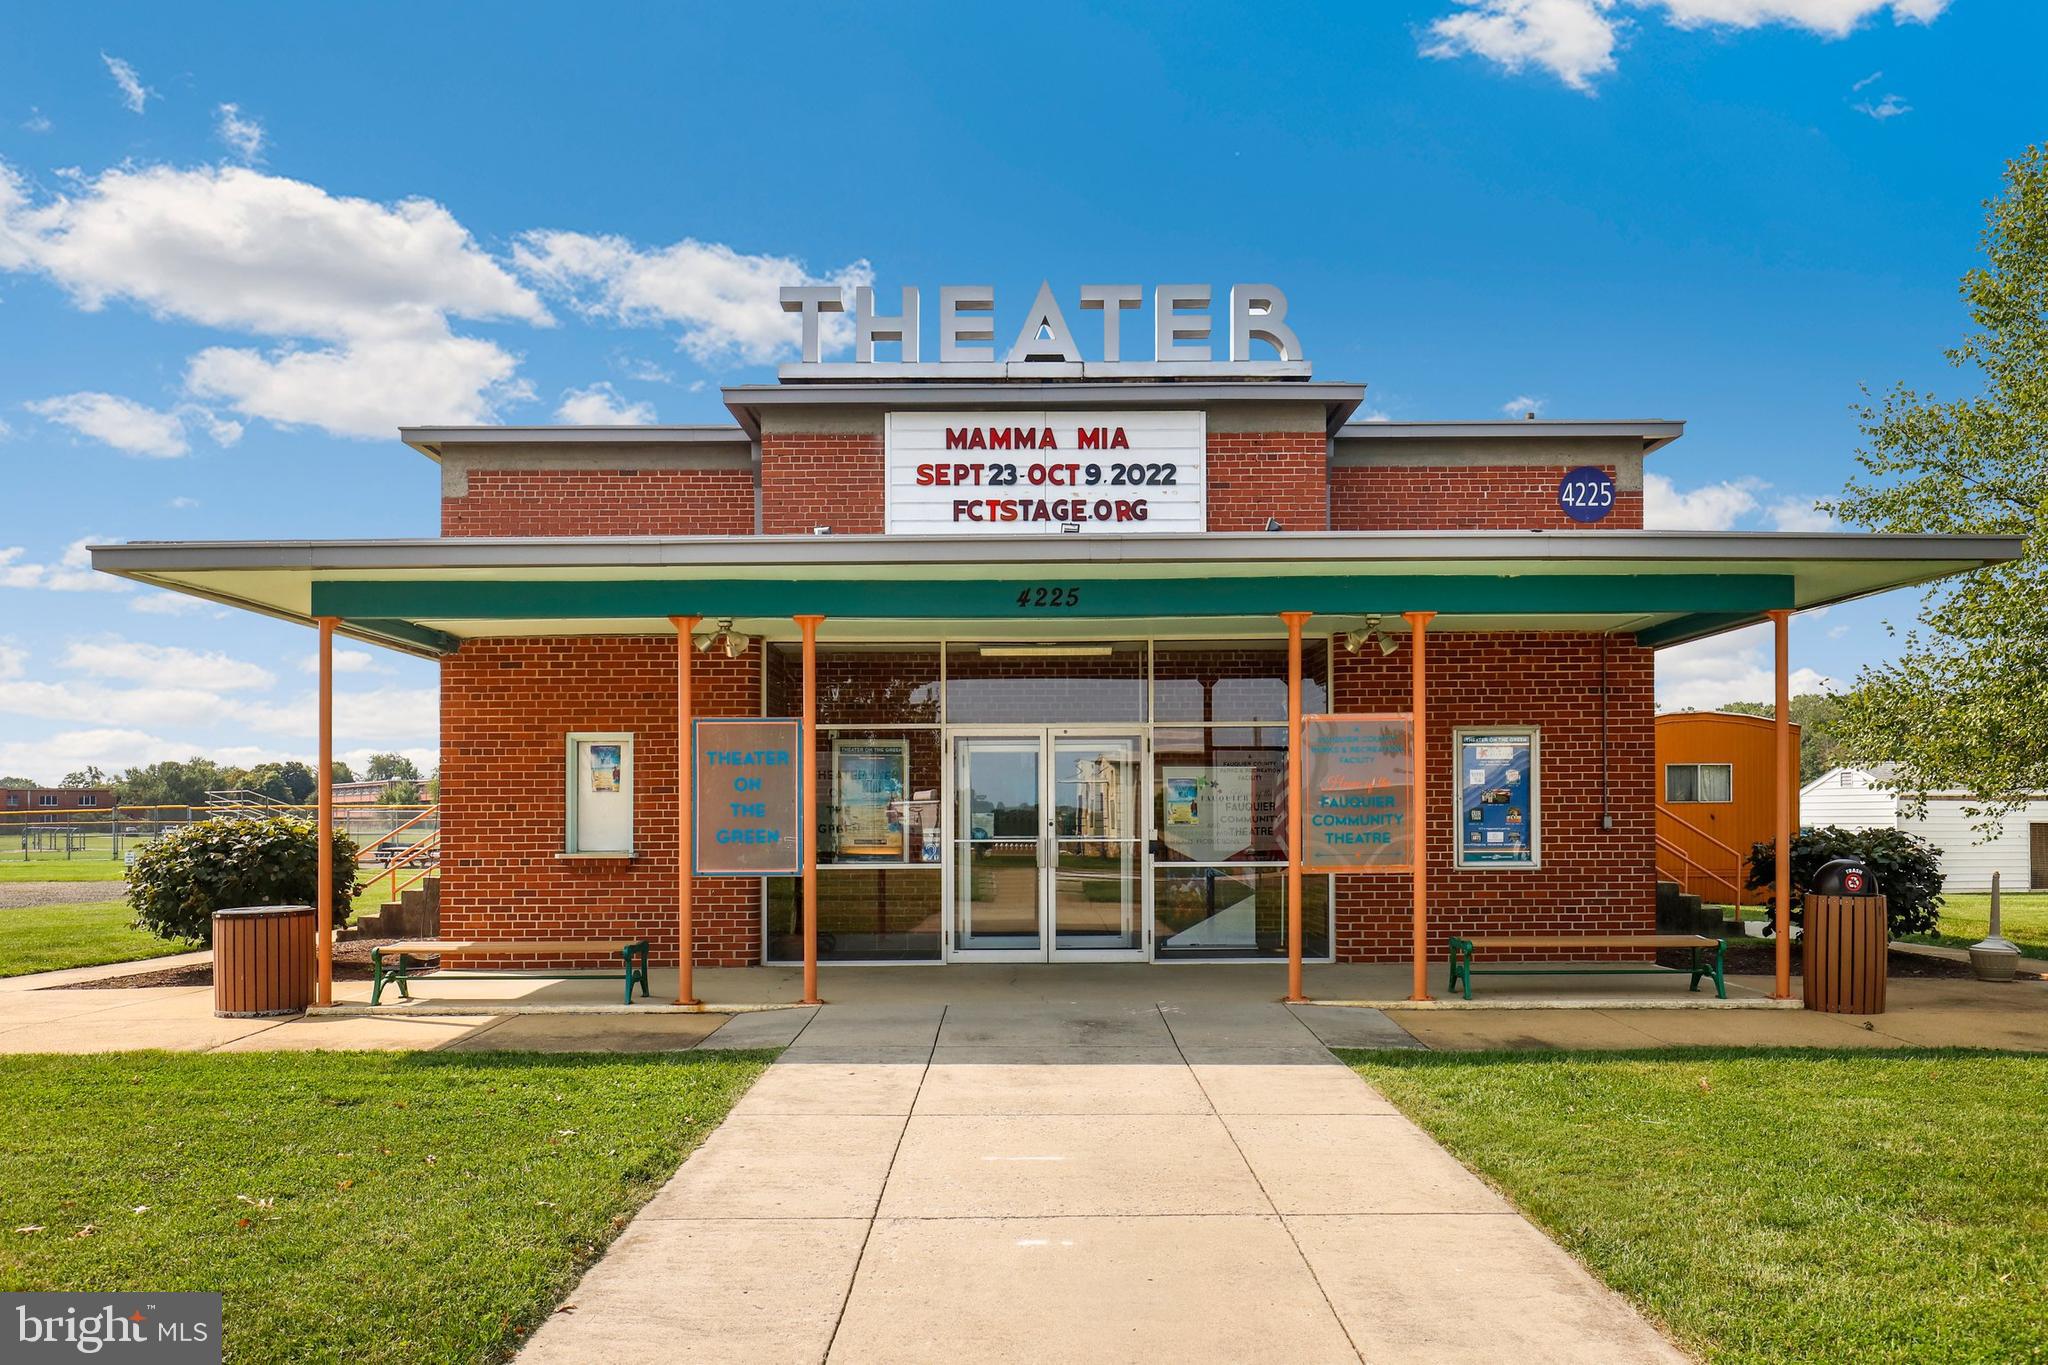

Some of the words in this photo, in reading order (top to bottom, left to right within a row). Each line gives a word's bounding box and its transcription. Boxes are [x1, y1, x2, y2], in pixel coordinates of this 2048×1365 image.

[780, 279, 1303, 363] THEATER
[946, 427, 1058, 450] MAMMA
[1078, 427, 1130, 450] MIA
[916, 463, 985, 486] SEPT
[1562, 482, 1612, 507] 4225
[953, 499, 1148, 522] FCTSTAGE.ORG
[1016, 587, 1080, 608] 4225
[706, 751, 790, 766] THEATER
[733, 776, 762, 792] ON
[1225, 801, 1276, 812] FAUQUIER
[1319, 795, 1395, 808] FAUQUIER
[729, 802, 766, 818] THE
[1220, 815, 1282, 824] COMMUNITY
[1311, 814, 1404, 827] COMMUNITY
[716, 829, 780, 844] GREEN
[1230, 826, 1274, 836] THEATRE
[1324, 831, 1392, 845] THEATRE
